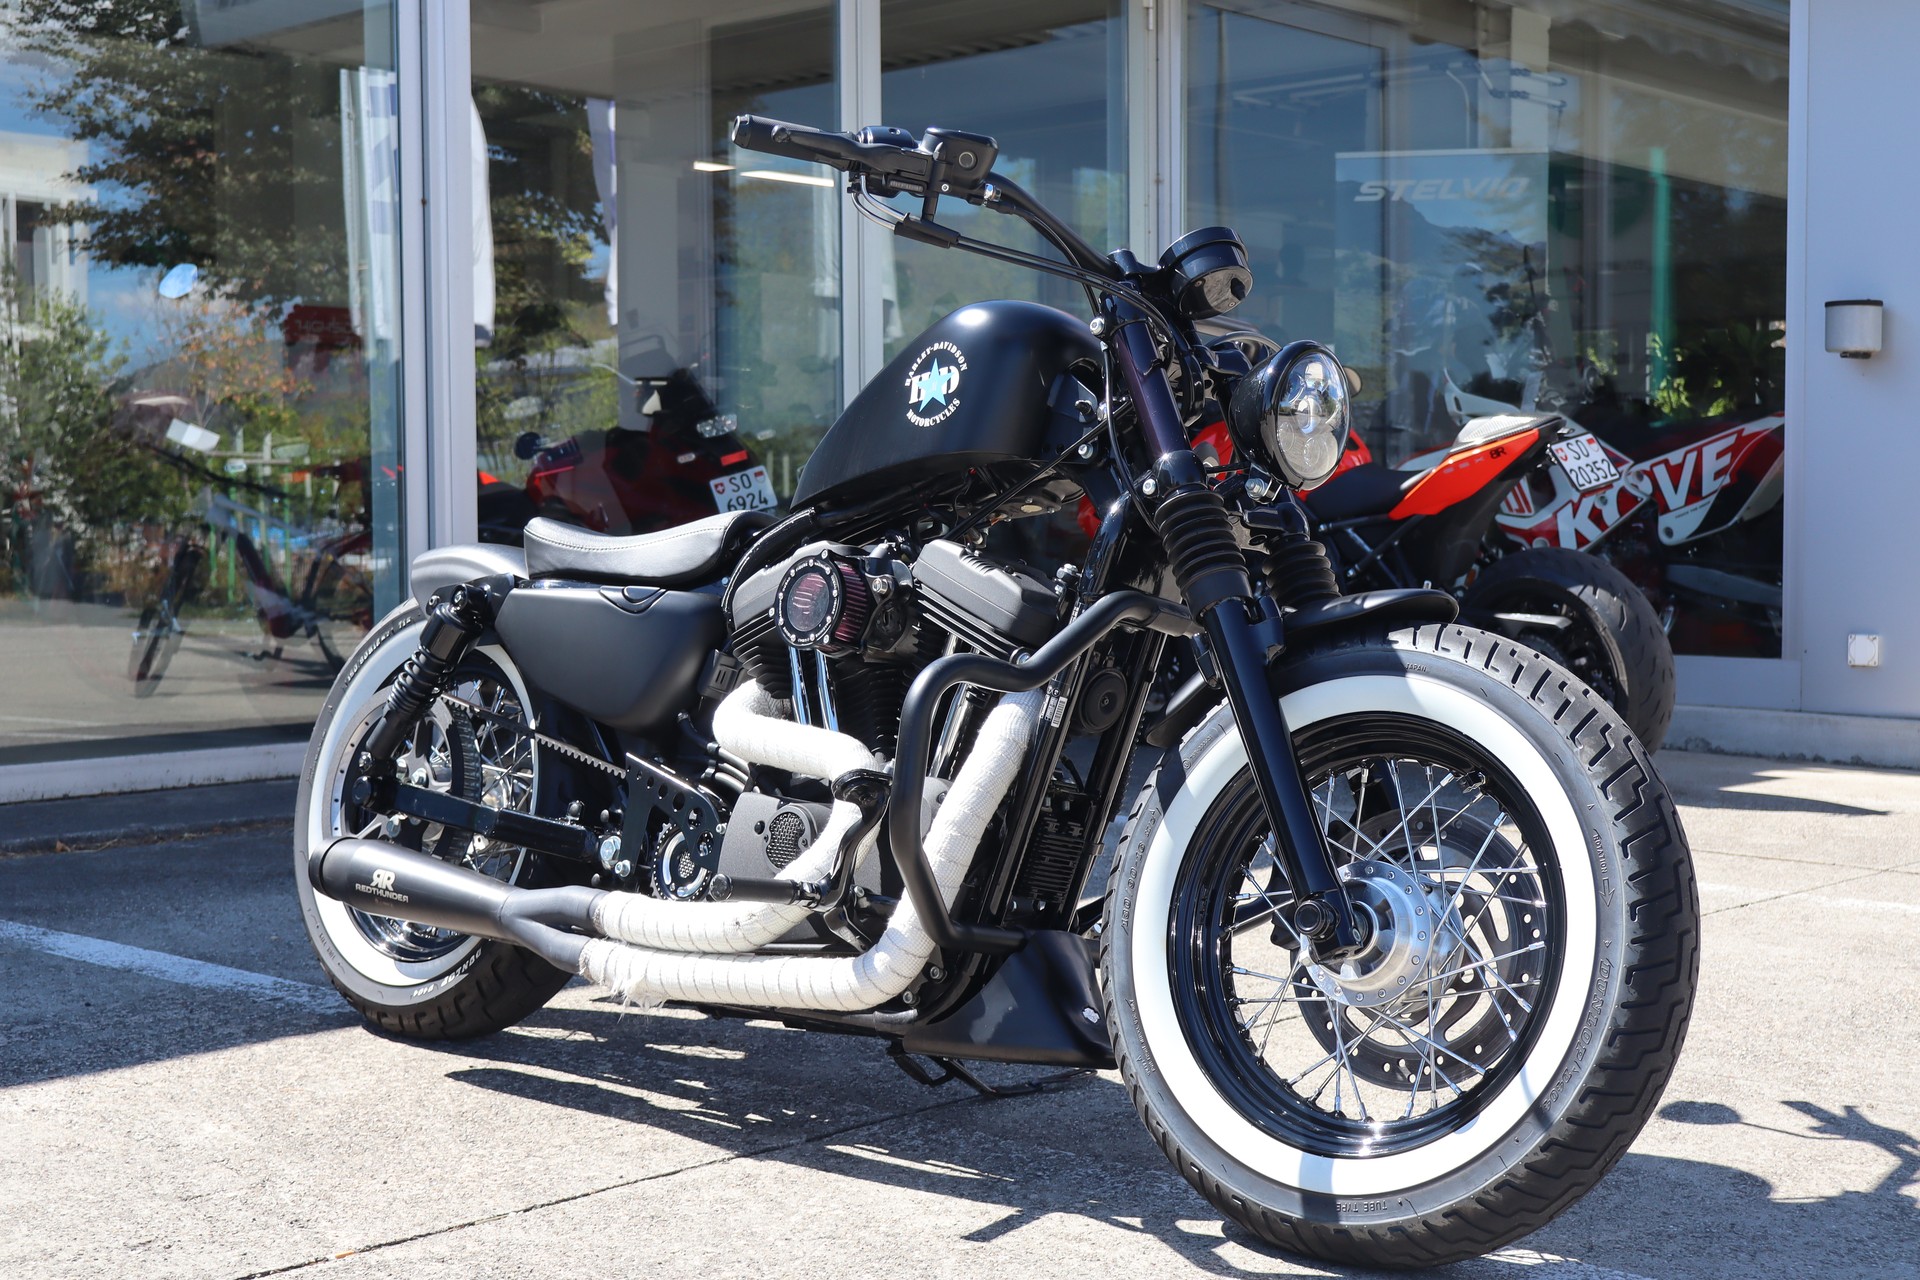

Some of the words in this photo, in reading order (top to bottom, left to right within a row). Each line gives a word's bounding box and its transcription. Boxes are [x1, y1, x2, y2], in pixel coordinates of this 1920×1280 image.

[1354, 177, 1530, 202] STELVIO
[905, 341, 967, 386] HARLEY-DAVIDSON
[906, 398, 960, 427] MOTORCYCLES
[1565, 439, 1589, 461] SO
[729, 473, 752, 493] SO
[1569, 459, 1612, 488] 20352
[727, 490, 768, 512] 6924
[1406, 662, 1427, 672] JAPAN
[1593, 834, 1608, 874] ROTATION
[355, 883, 409, 903] REDTHUNDER
[1575, 958, 1612, 1061] DUNLOP
[1336, 1202, 1358, 1213] TYPE
[1364, 1200, 1388, 1212] TUBE
